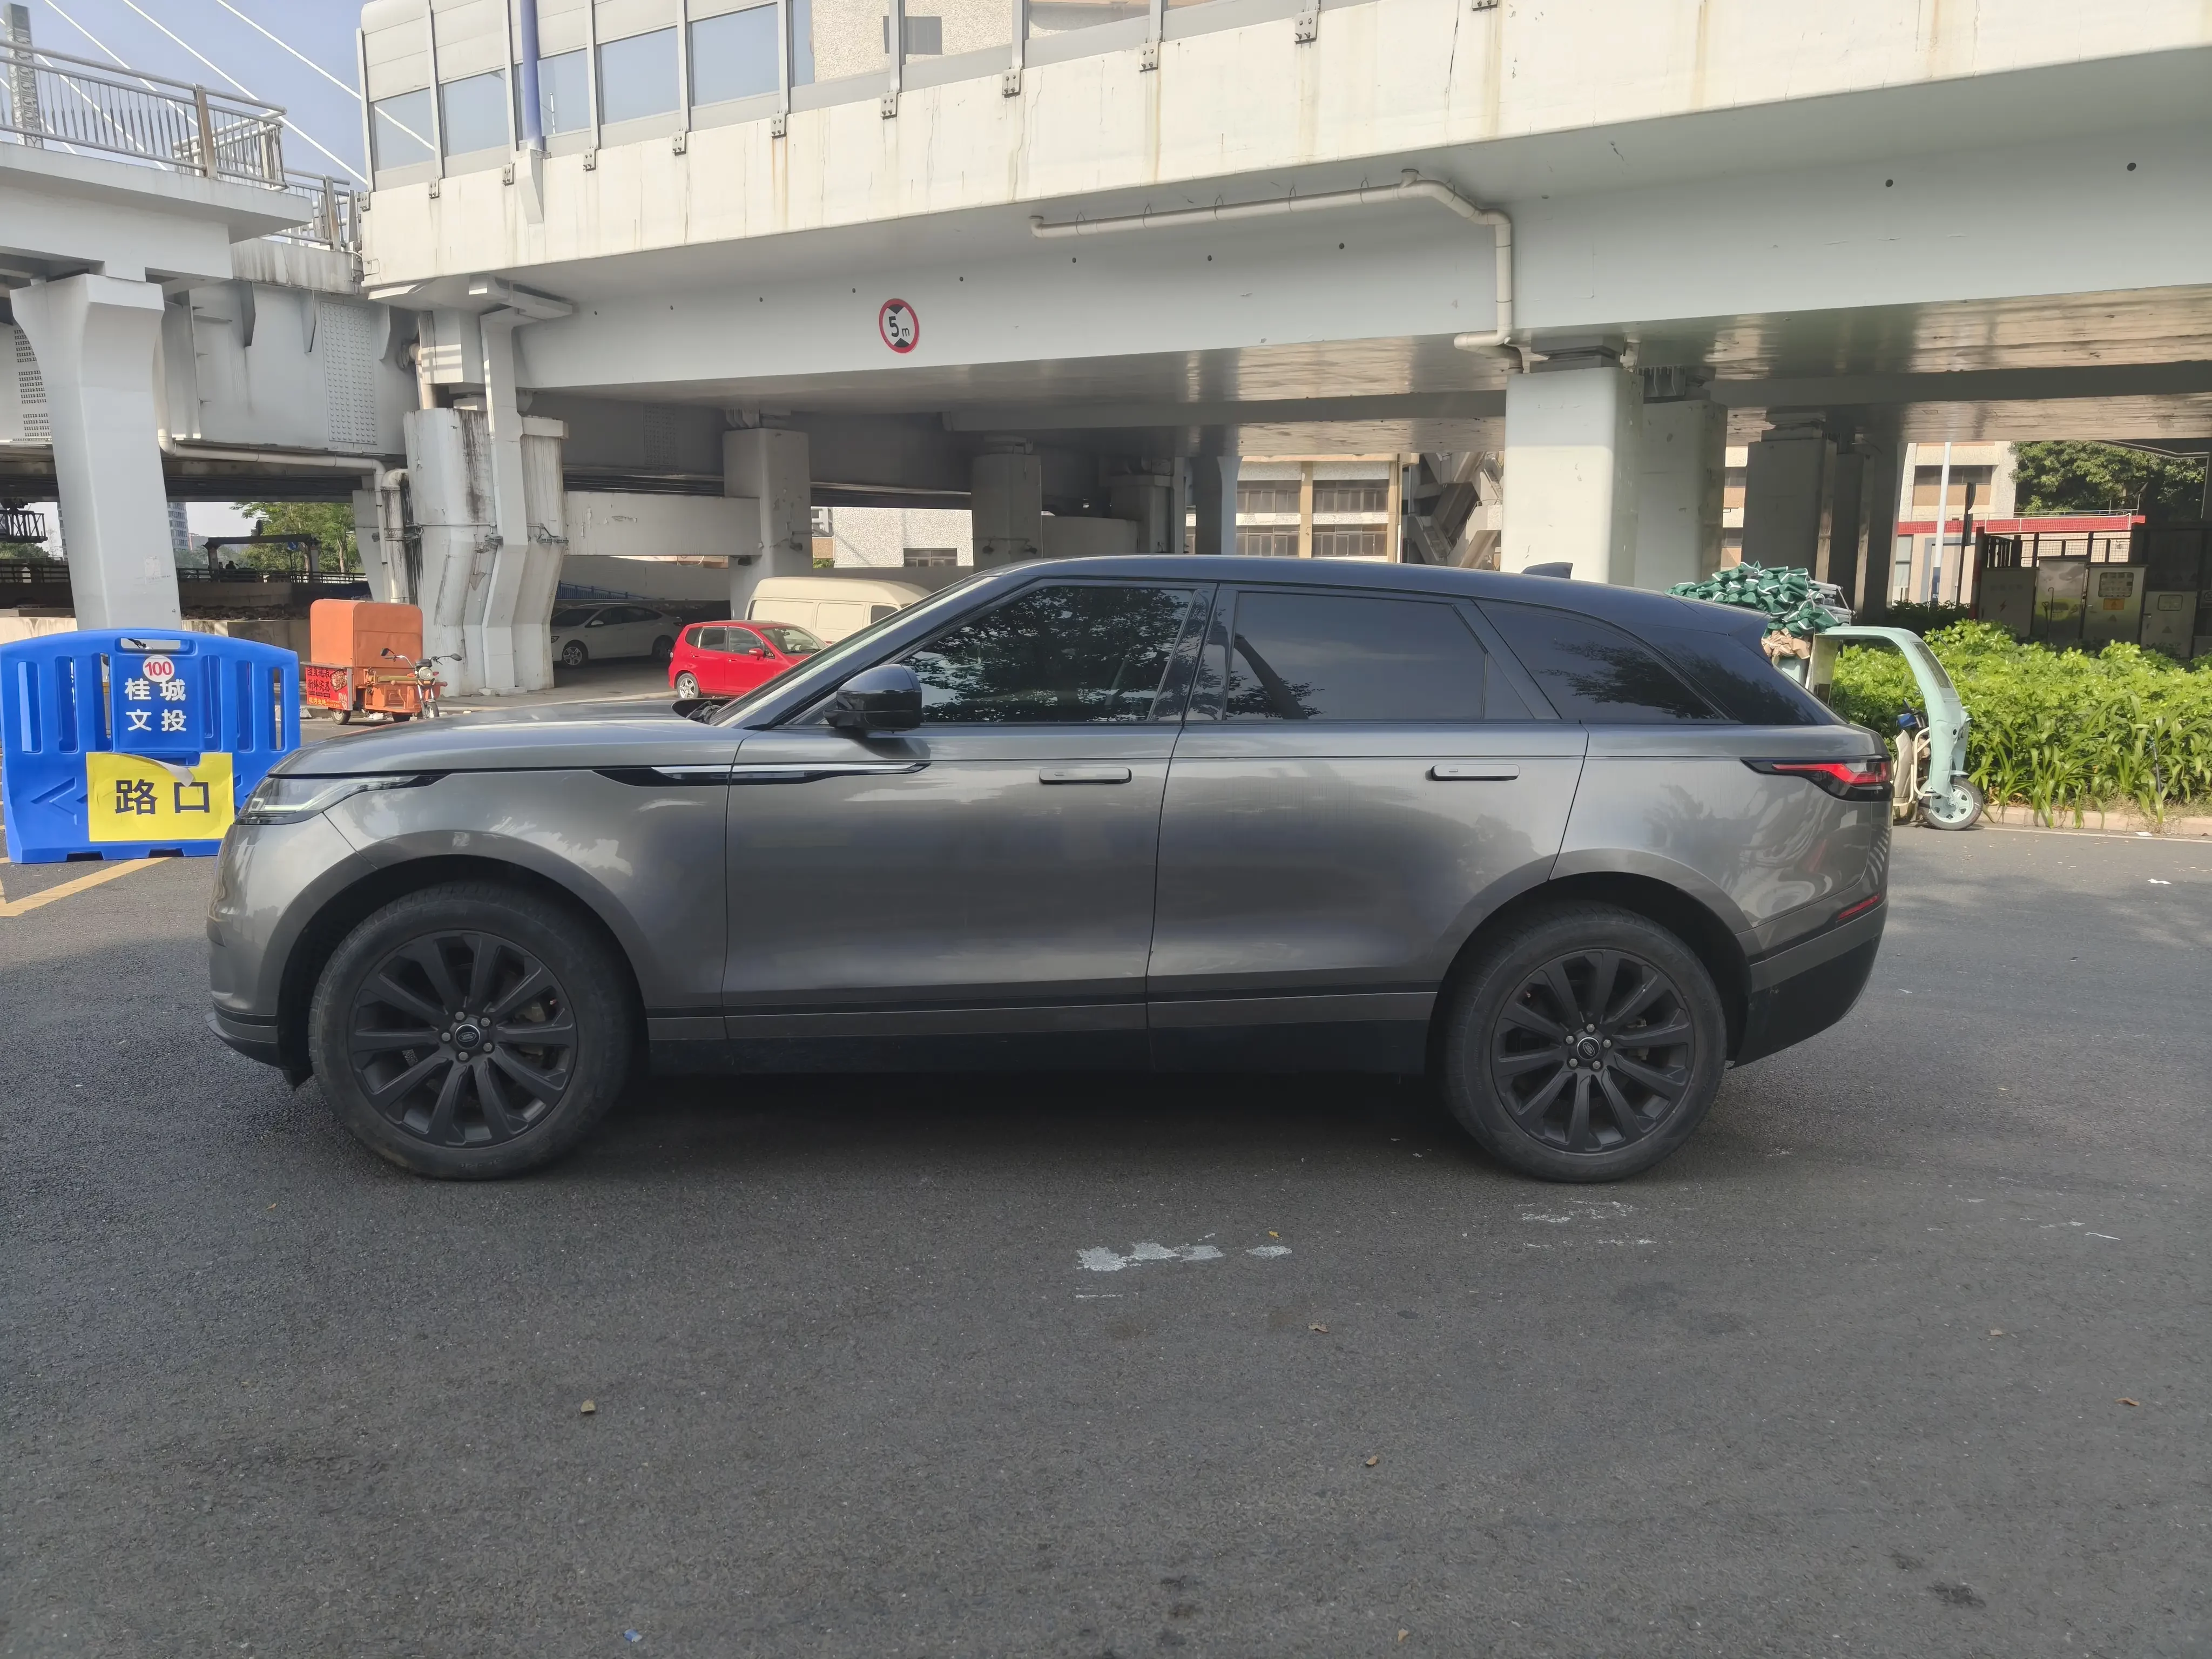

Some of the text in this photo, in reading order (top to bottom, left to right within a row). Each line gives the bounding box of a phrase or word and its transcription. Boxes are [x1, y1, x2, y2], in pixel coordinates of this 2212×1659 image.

[145, 661, 172, 676] 100
[124, 678, 186, 700] 桂城
[125, 709, 187, 731] 文投
[114, 779, 210, 814] 路口
